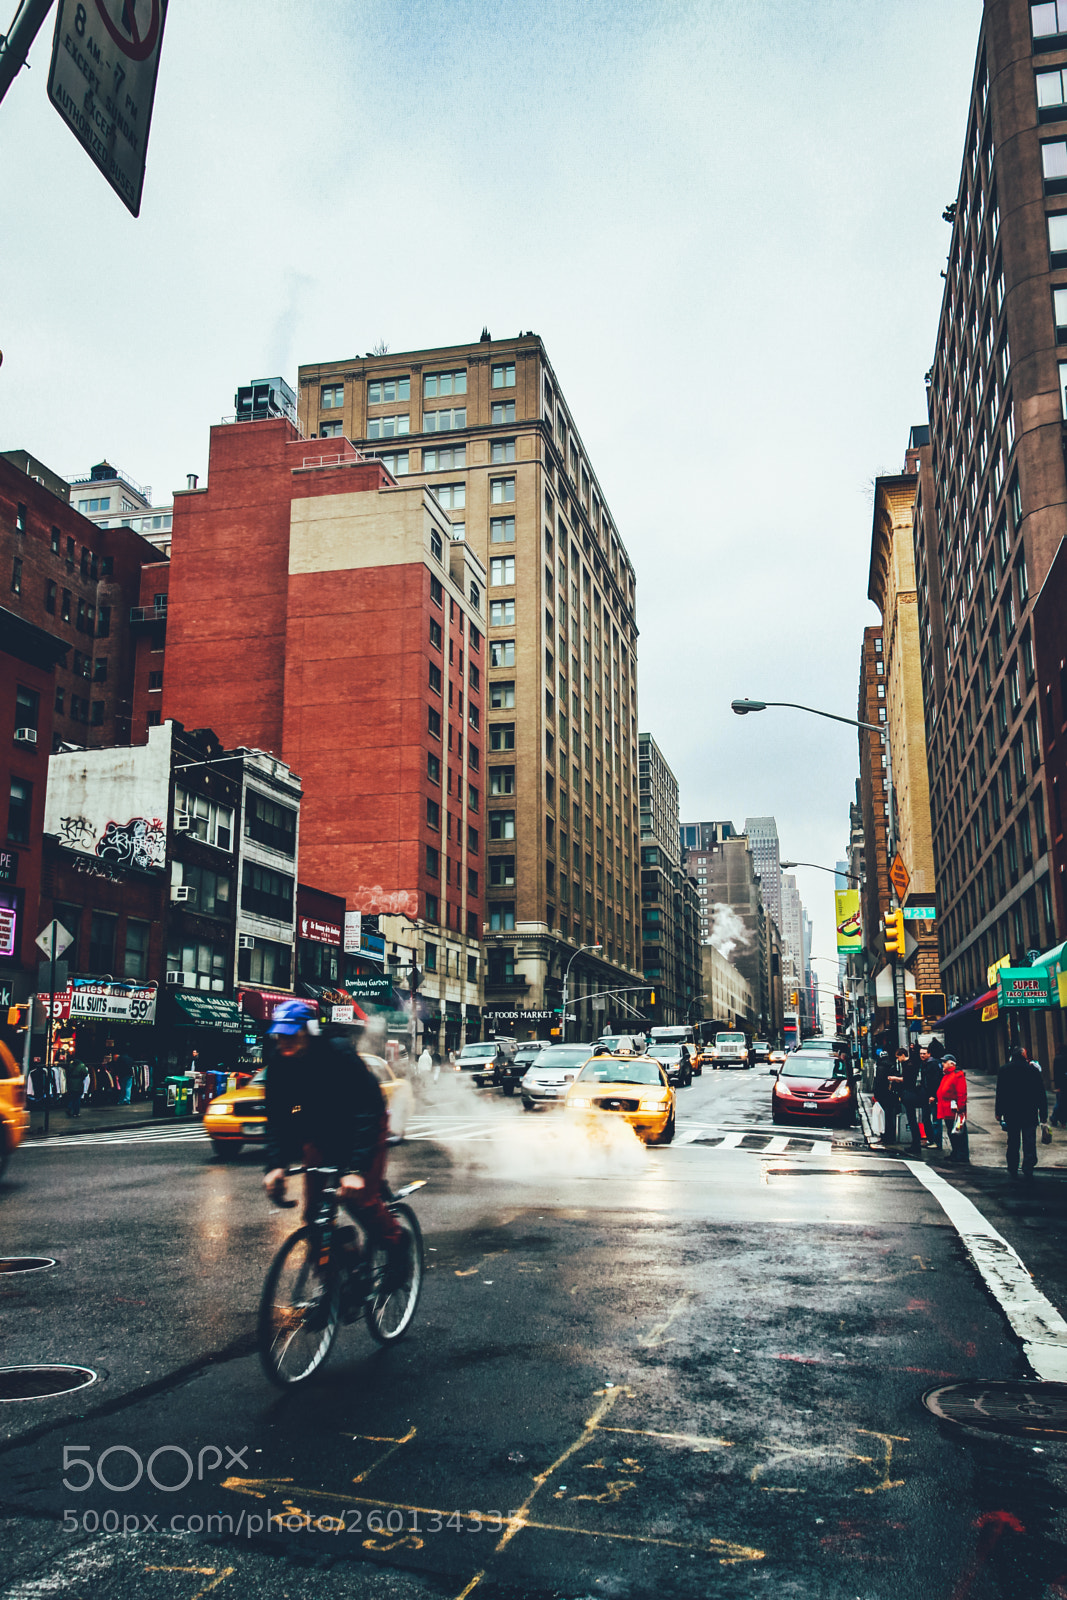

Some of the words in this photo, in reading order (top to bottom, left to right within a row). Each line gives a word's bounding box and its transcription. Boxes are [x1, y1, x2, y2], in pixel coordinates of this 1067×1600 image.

[74, 3, 87, 38] 8
[114, 62, 126, 95] 7
[125, 93, 138, 121] PM
[65, 33, 101, 94] EXCEPT
[105, 96, 138, 151] SUNDAY
[56, 83, 108, 164] AUTHORIZED
[109, 158, 136, 201] BUSES
[0, 852, 12, 868] PE
[904, 909, 911, 918] W
[913, 909, 927, 918] 23
[345, 978, 368, 988] Bombay
[368, 978, 389, 987] Garden
[1012, 980, 1039, 990] SUPER
[1006, 990, 1022, 998] TACO
[1023, 990, 1048, 998] EXPRESS
[72, 994, 85, 1011] ALL
[86, 996, 107, 1013] SUITS
[495, 1011, 519, 1019] FOODS
[520, 1011, 553, 1019] MARKET
